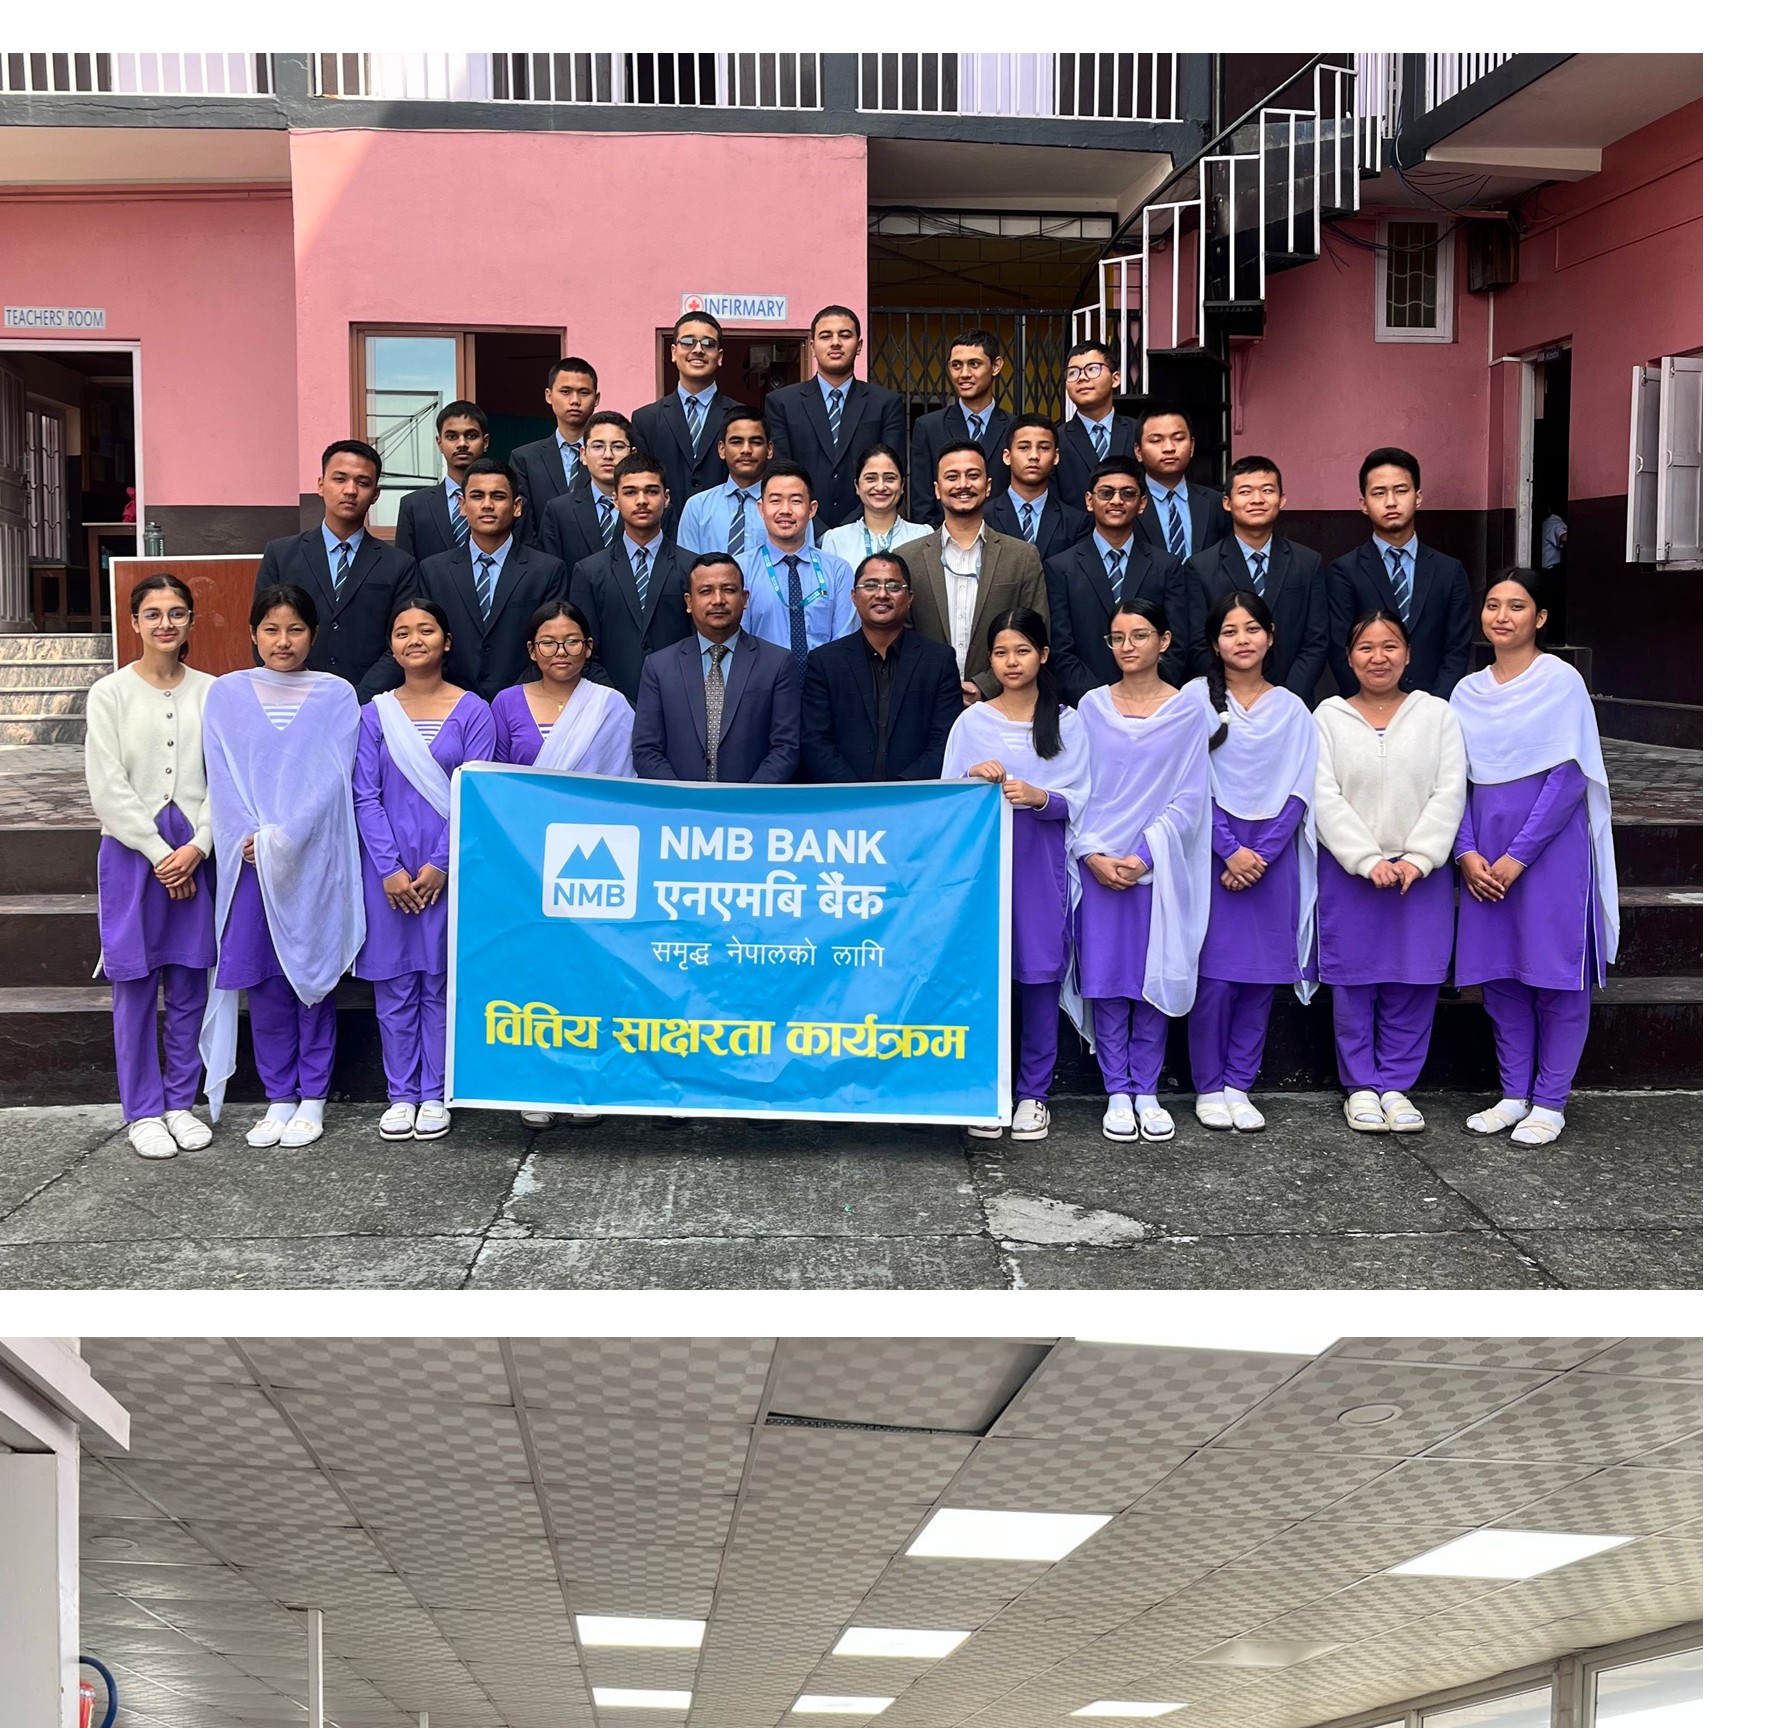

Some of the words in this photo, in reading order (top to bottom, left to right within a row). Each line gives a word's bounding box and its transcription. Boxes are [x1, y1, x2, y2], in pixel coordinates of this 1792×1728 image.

[6, 309, 65, 325] TEACHERS'
[68, 310, 104, 326] ROOM
[704, 298, 785, 317] INFIRMARY
[660, 825, 754, 862] NMB
[768, 828, 887, 865] BANK
[554, 882, 625, 908] NMB
[654, 870, 807, 921] एनएमबि
[816, 870, 886, 919] बैंक
[651, 940, 712, 970] समृद्ध
[726, 935, 816, 967] नेपालको
[831, 938, 885, 968] लागि
[612, 1015, 776, 1060] साक्षरता
[786, 1014, 969, 1060] कार्यक्रम
